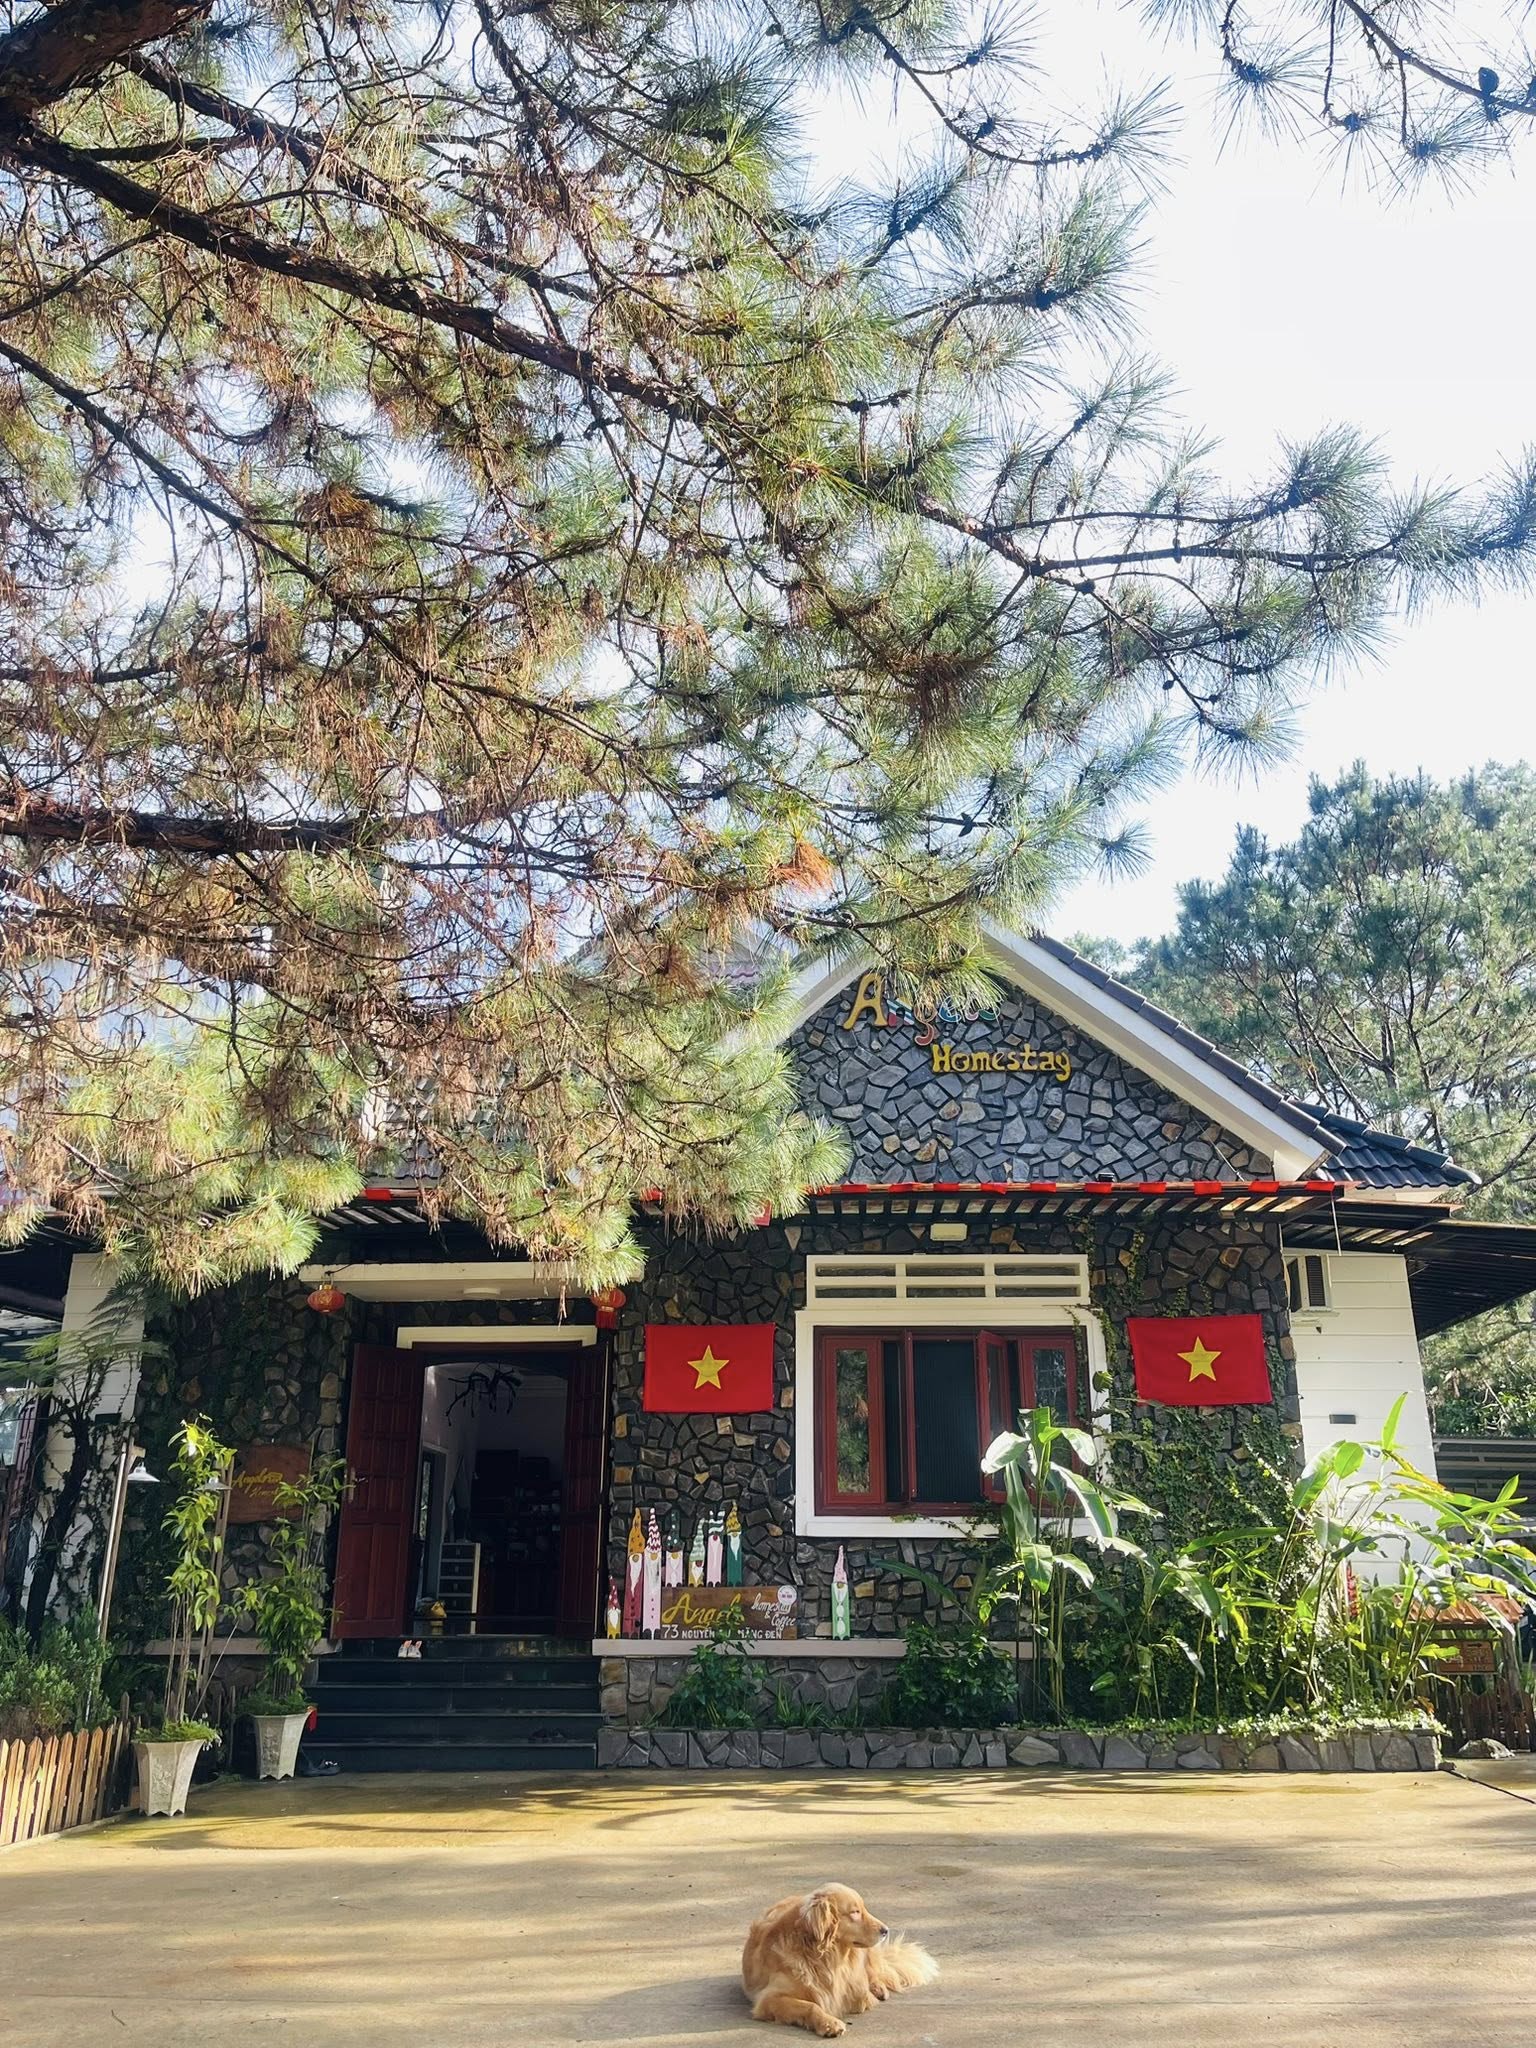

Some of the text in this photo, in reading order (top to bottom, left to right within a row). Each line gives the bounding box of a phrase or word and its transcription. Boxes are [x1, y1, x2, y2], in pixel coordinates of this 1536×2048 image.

[843, 973, 1000, 1045] Ange
[932, 1043, 1071, 1082] Homestay
[764, 1610, 771, 1619] &
[771, 1613, 797, 1631] Coffee
[662, 1624, 679, 1639] 73
